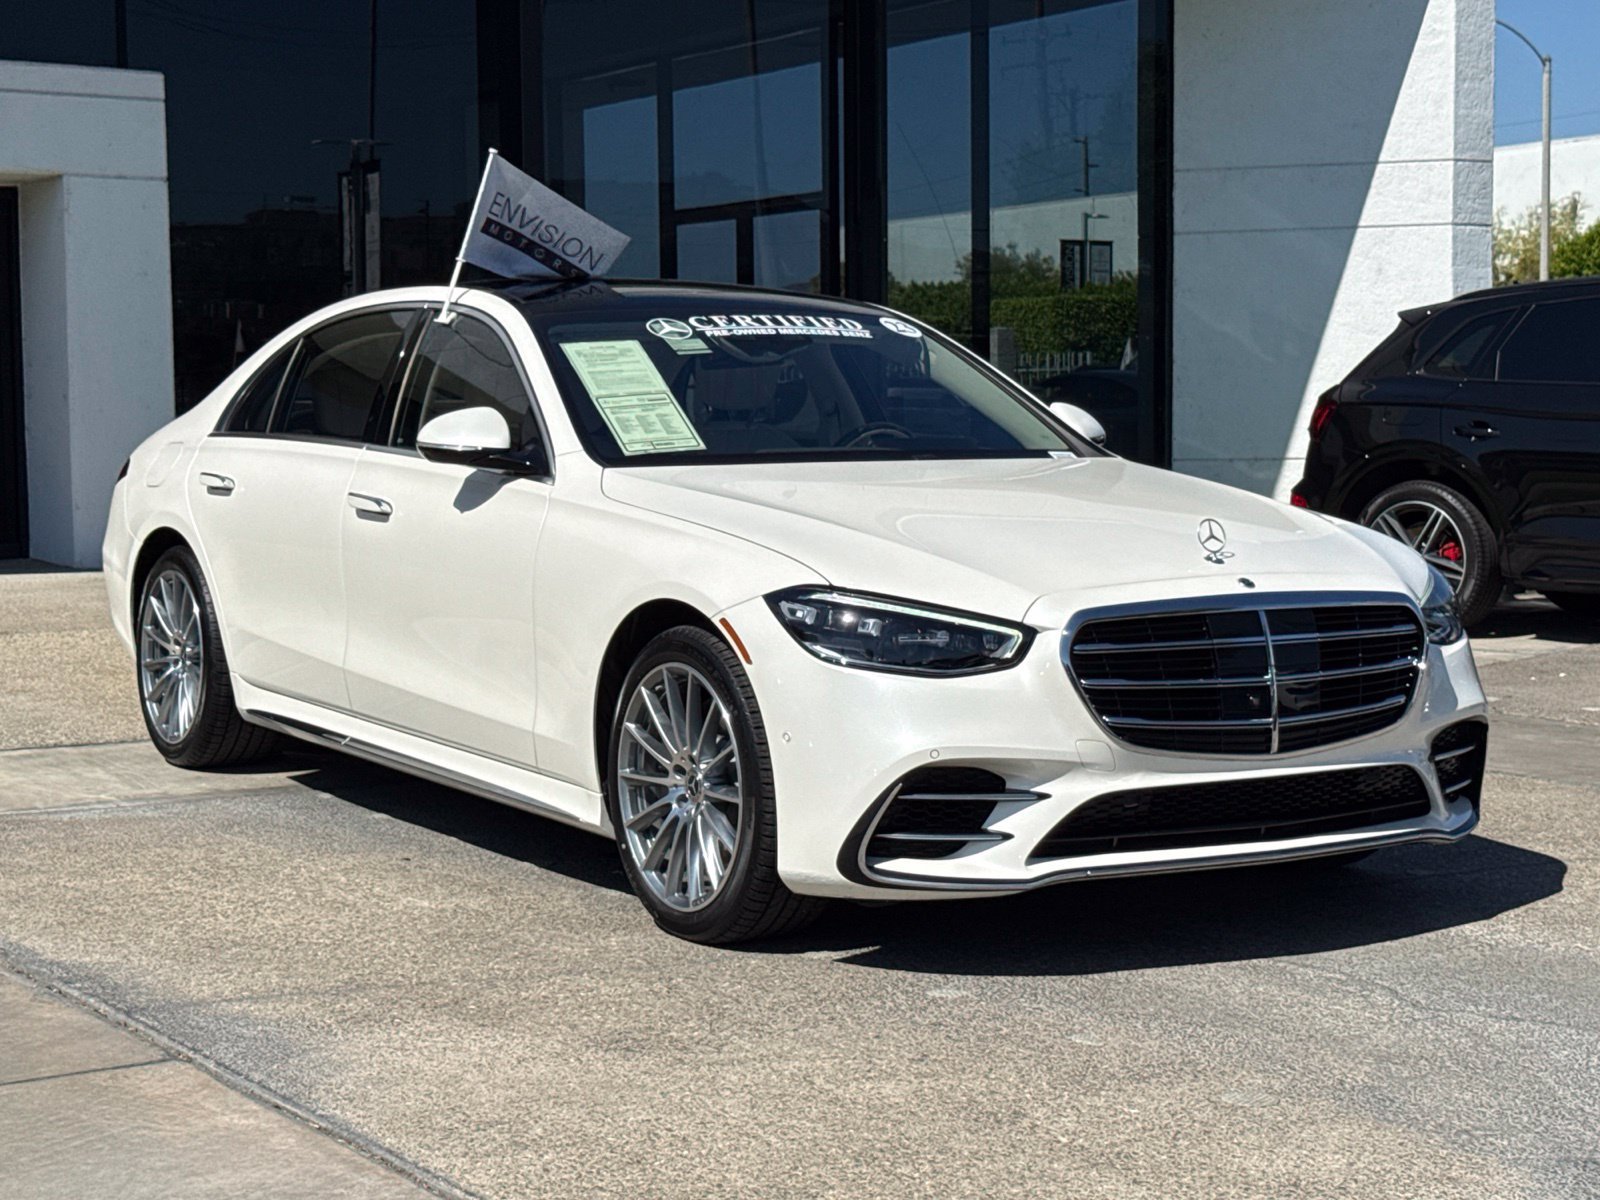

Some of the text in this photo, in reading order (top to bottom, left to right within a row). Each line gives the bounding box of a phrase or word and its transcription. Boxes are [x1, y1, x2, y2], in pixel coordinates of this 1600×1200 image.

[488, 191, 604, 271] ENVISION
[489, 223, 578, 278] MOTORS
[688, 314, 862, 330] CERTIFIED
[704, 328, 874, 339] PRE-OWNED MERCEDES BENZ
